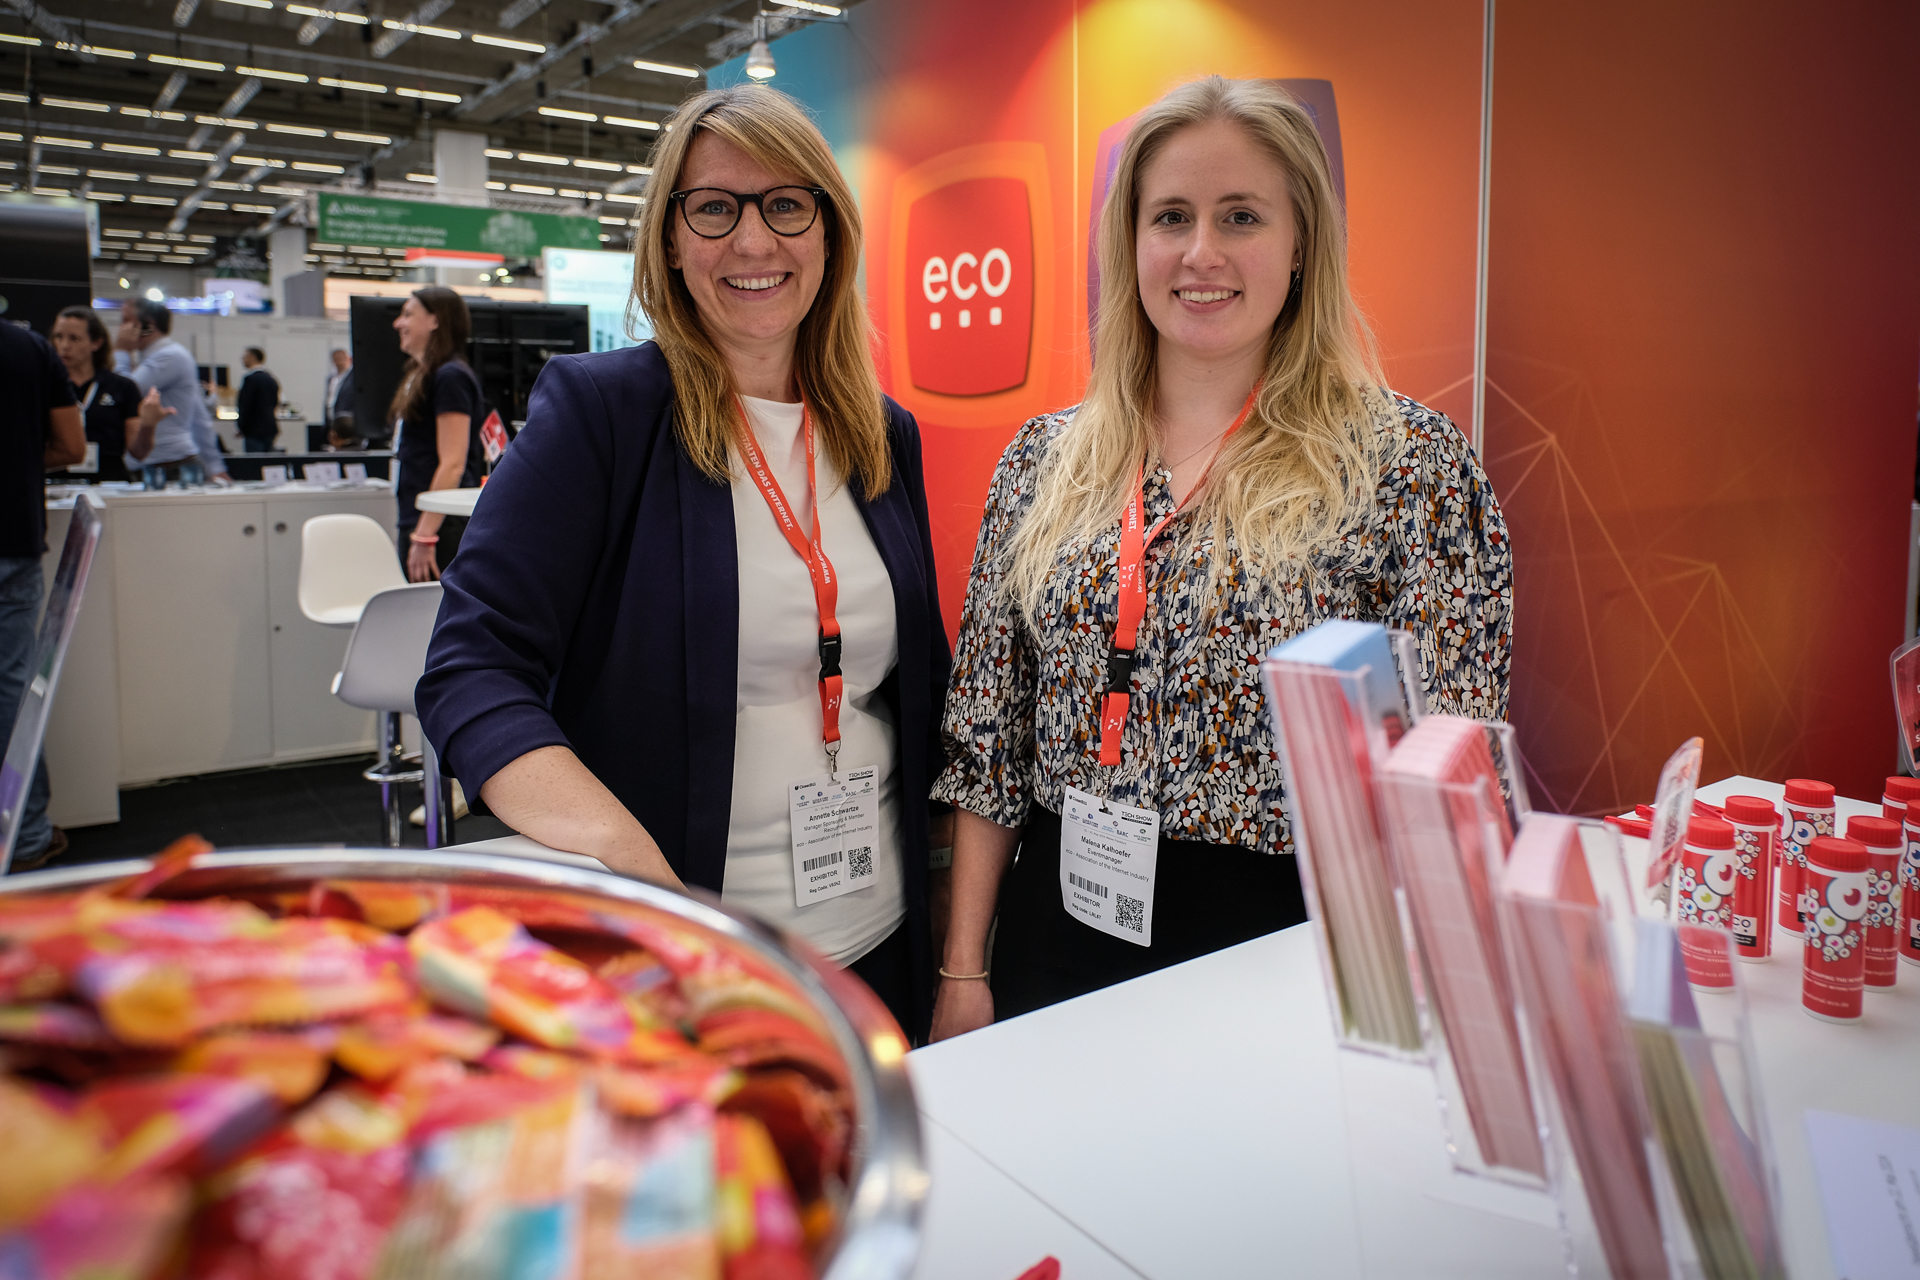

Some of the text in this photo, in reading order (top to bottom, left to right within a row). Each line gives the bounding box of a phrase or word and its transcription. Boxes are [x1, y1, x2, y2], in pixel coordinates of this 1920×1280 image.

[922, 246, 1012, 304] eco
[757, 469, 772, 488] DAS
[767, 488, 794, 531] INTERNET.
[809, 811, 831, 822] Annette
[831, 805, 860, 817] Schwartze
[1135, 814, 1153, 822] SHOW
[803, 823, 822, 831] Manager
[807, 835, 831, 845] Association
[1080, 835, 1132, 859] Malena Kalhoefer
[1087, 847, 1123, 865] Eventmanager
[1075, 852, 1099, 866] Association
[1111, 865, 1130, 876] Internet
[1129, 871, 1150, 882] Industry
[810, 870, 838, 883] EXHIBITOR
[1073, 891, 1101, 909] EXHIBITOR
